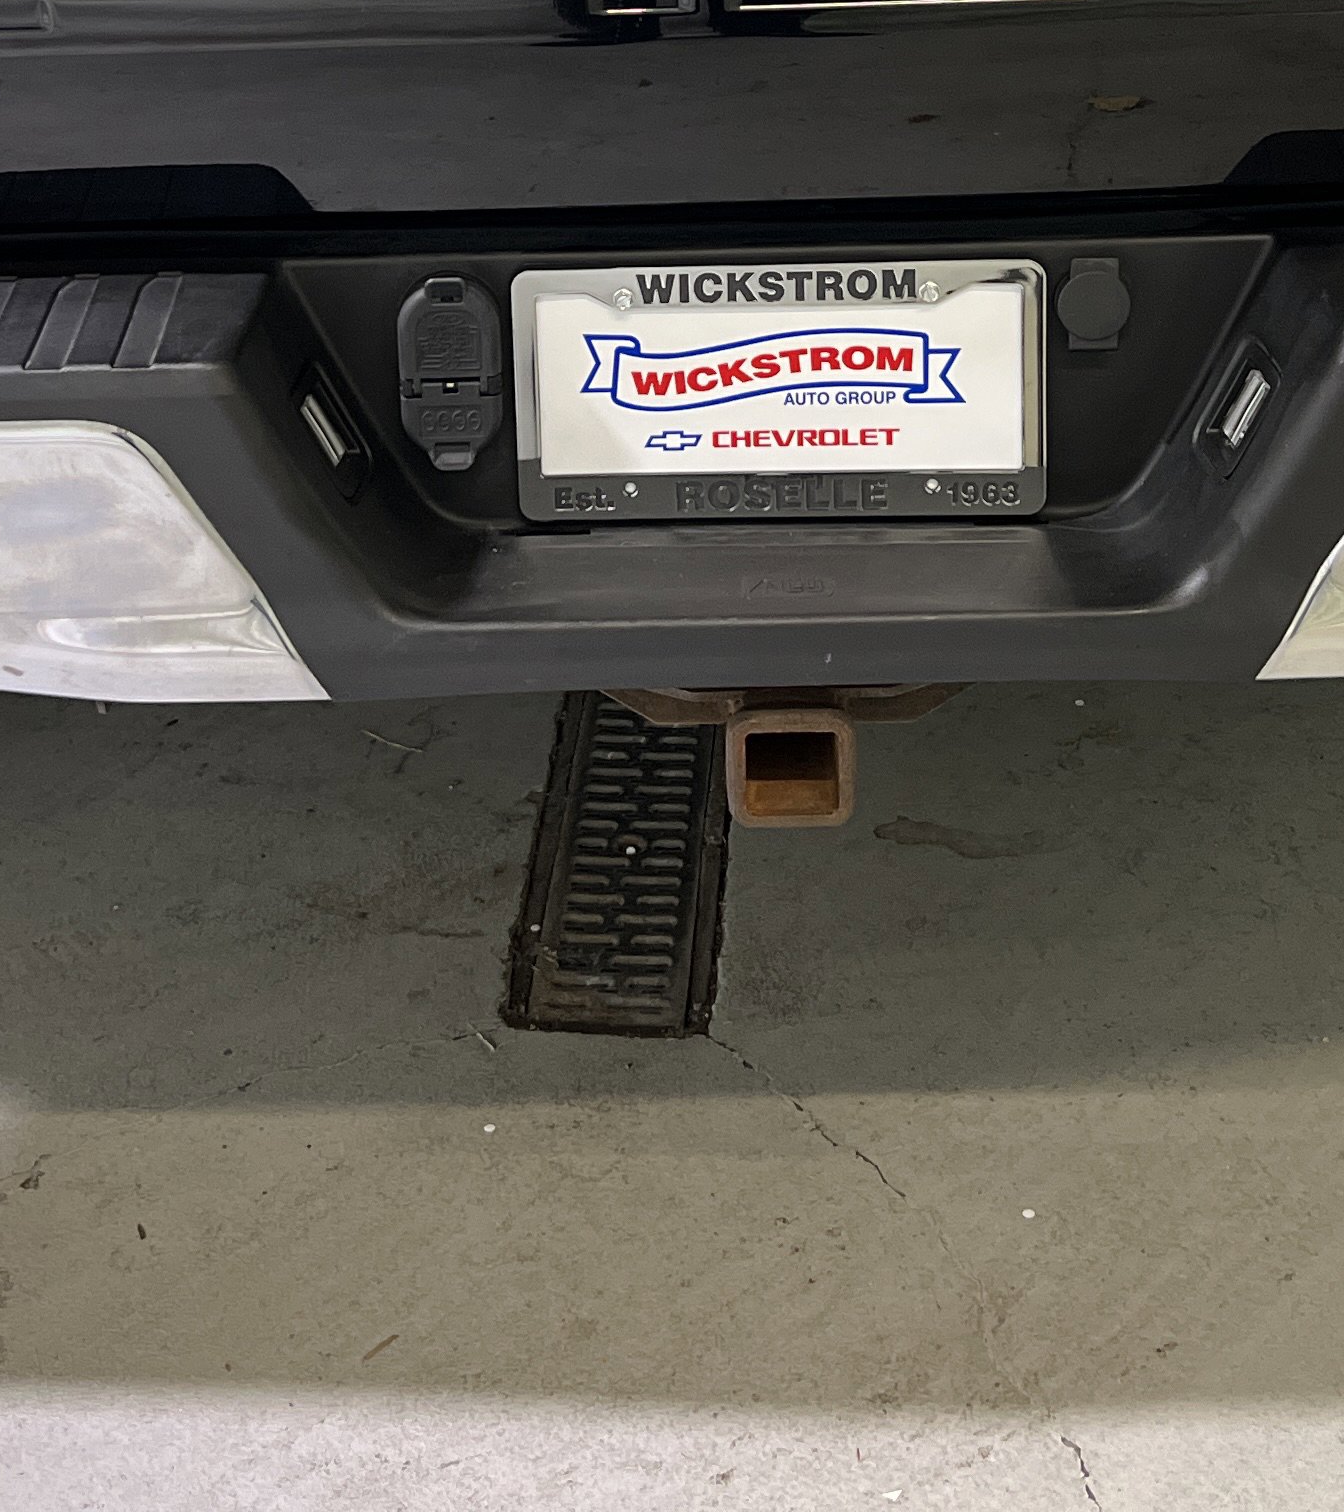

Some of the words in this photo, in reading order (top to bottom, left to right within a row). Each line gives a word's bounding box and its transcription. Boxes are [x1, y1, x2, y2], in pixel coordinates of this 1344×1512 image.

[636, 269, 917, 304] WICKSTROM
[632, 346, 914, 396] WICKSTROM
[784, 392, 830, 406] AUTO
[834, 391, 896, 405] GROUP
[712, 428, 901, 448] CHEVROLET
[555, 487, 616, 512] Est.
[675, 480, 888, 512] ROSELLE
[947, 481, 1021, 506] 1963
